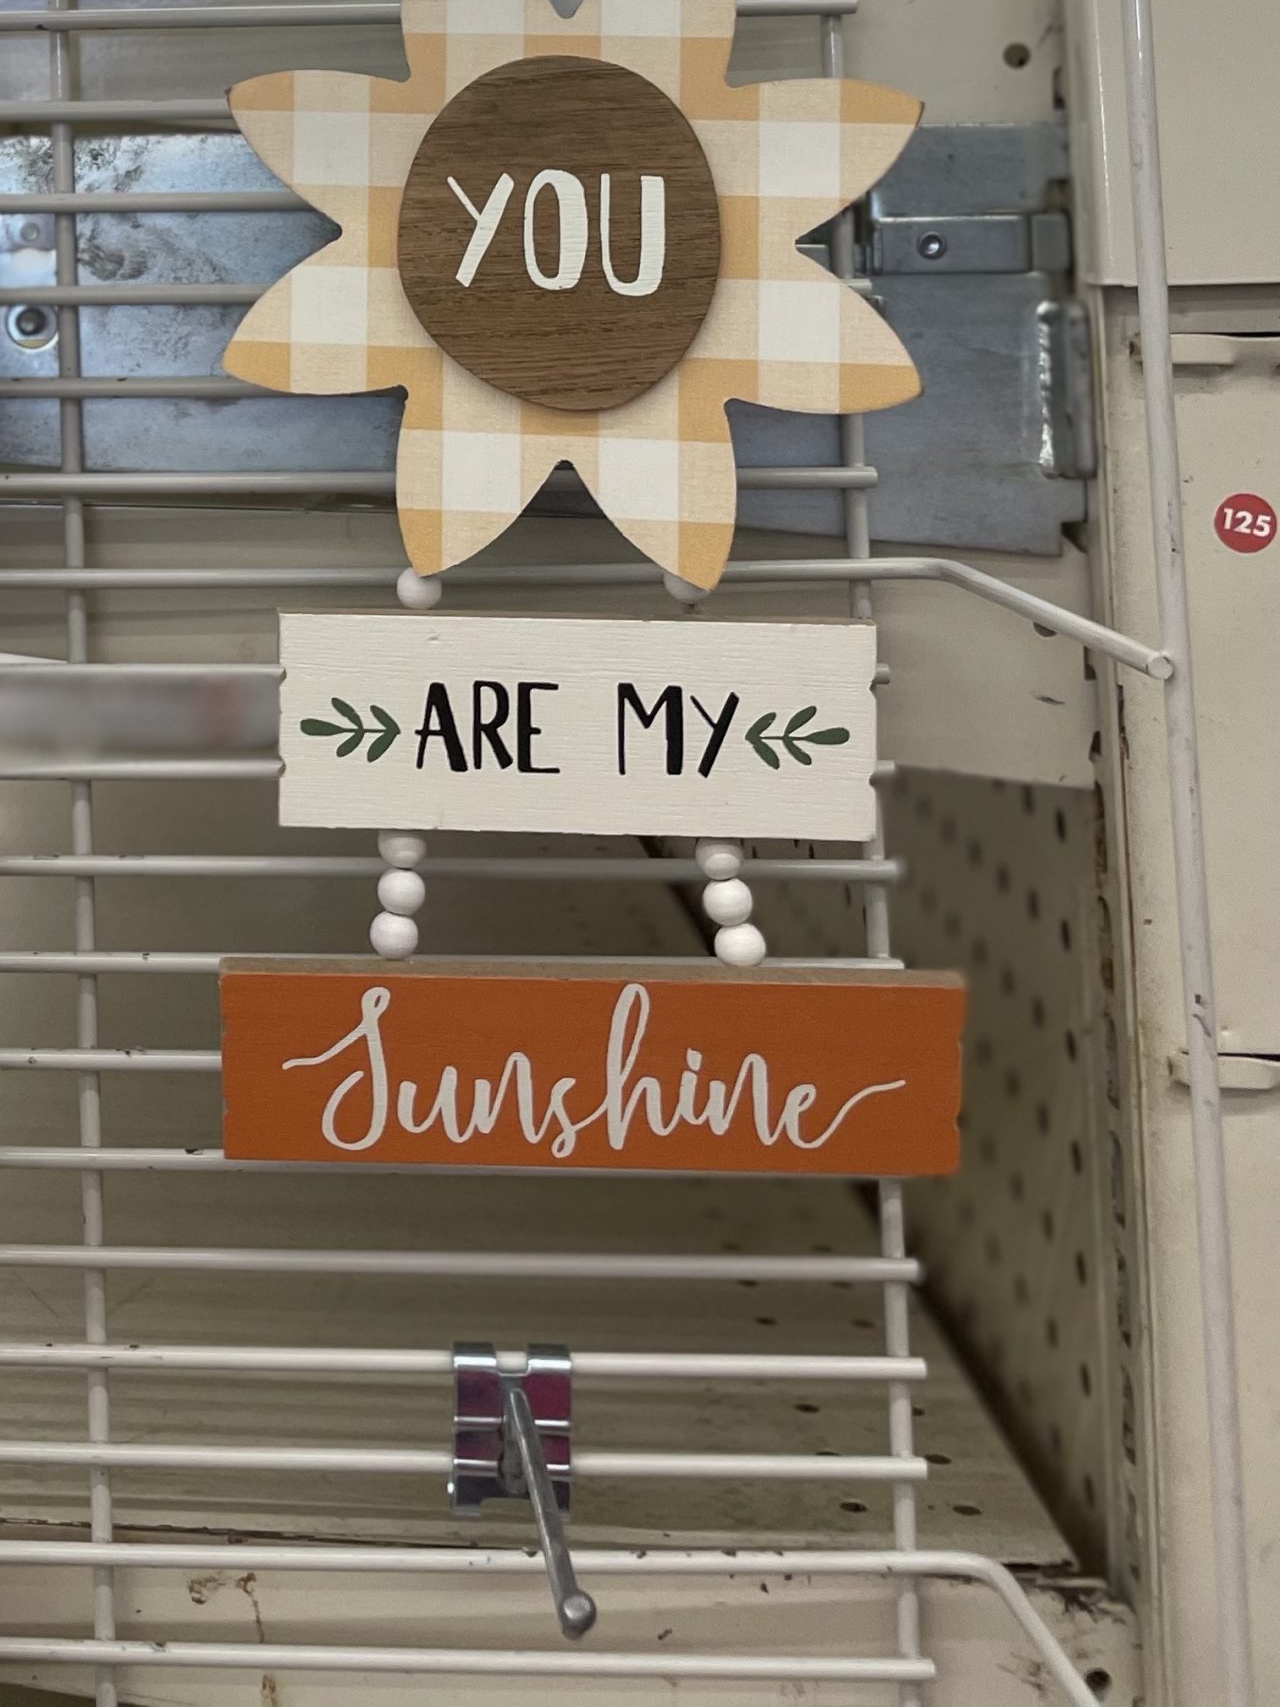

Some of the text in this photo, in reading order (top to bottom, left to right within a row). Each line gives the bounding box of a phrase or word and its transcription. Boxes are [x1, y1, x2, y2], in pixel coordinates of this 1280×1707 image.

[446, 168, 666, 296] YOU
[1223, 507, 1272, 538] 125
[415, 680, 741, 778] ARE MY
[282, 983, 906, 1157] Sunshine
